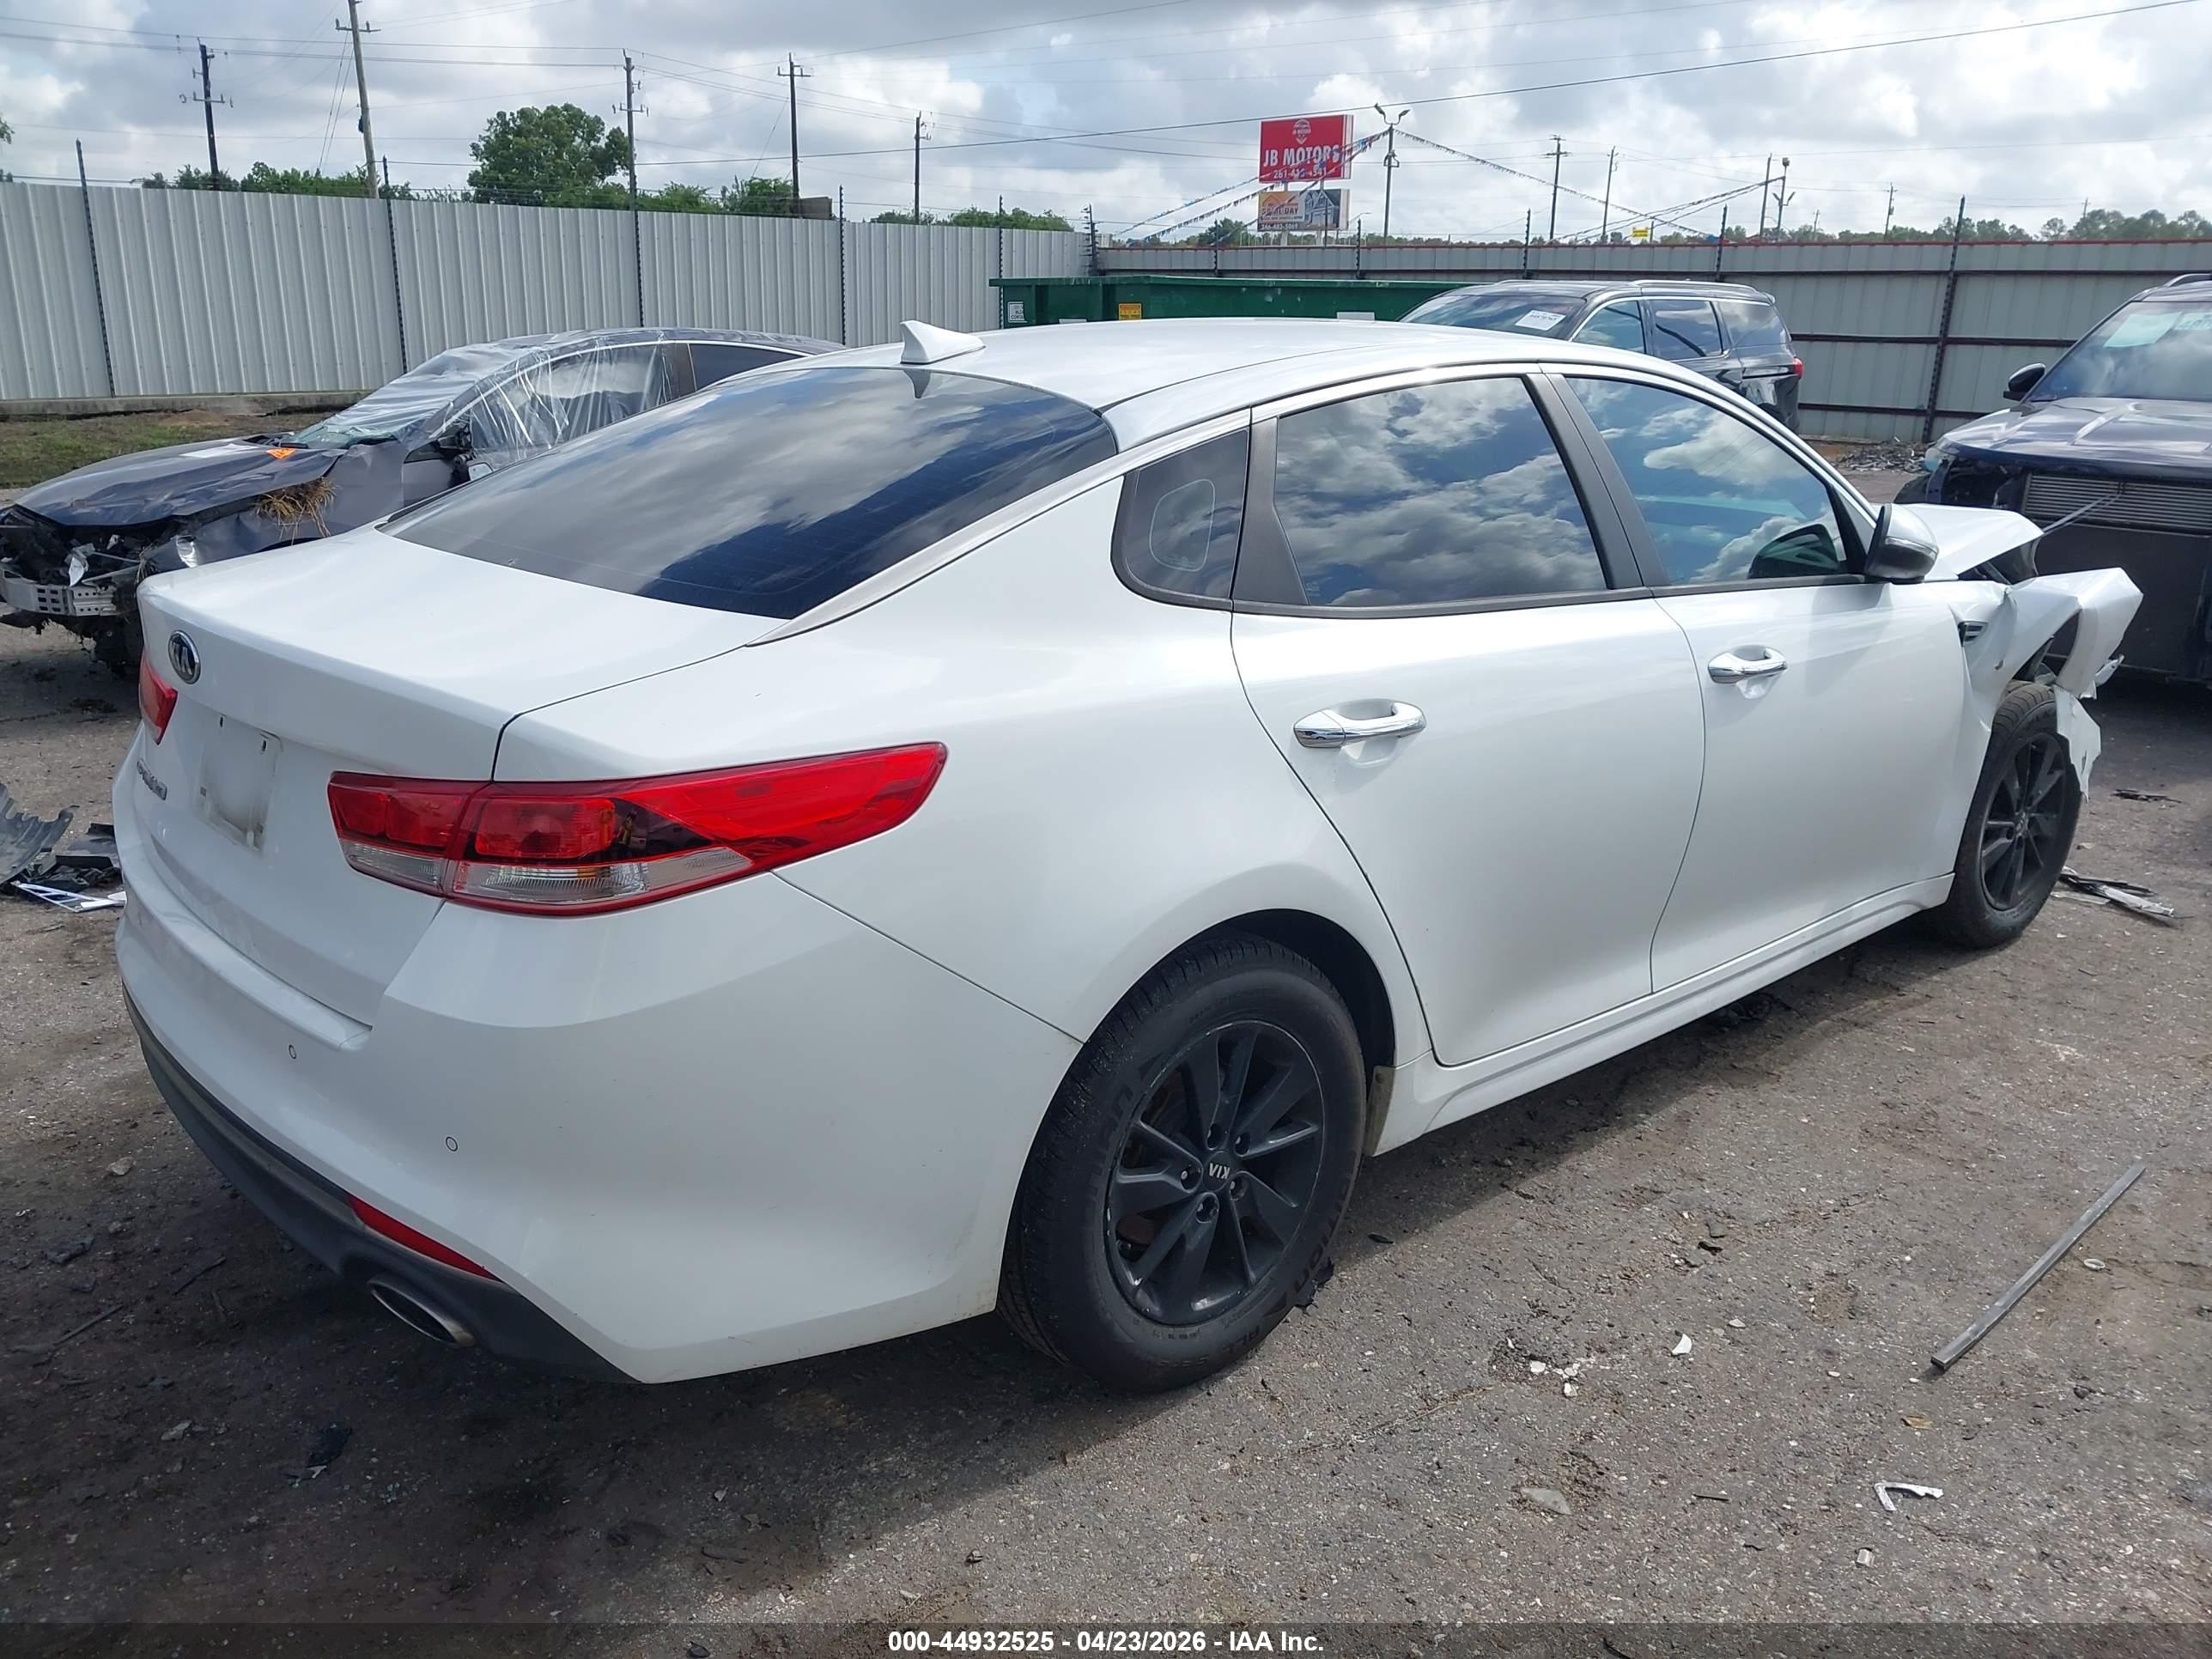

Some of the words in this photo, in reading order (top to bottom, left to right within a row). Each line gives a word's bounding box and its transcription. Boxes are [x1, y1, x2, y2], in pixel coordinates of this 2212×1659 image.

[1263, 149, 1279, 167] JB
[1283, 144, 1340, 166] MOTORS
[1285, 206, 1299, 215] DAY
[1209, 1163, 1231, 1179] KIA
